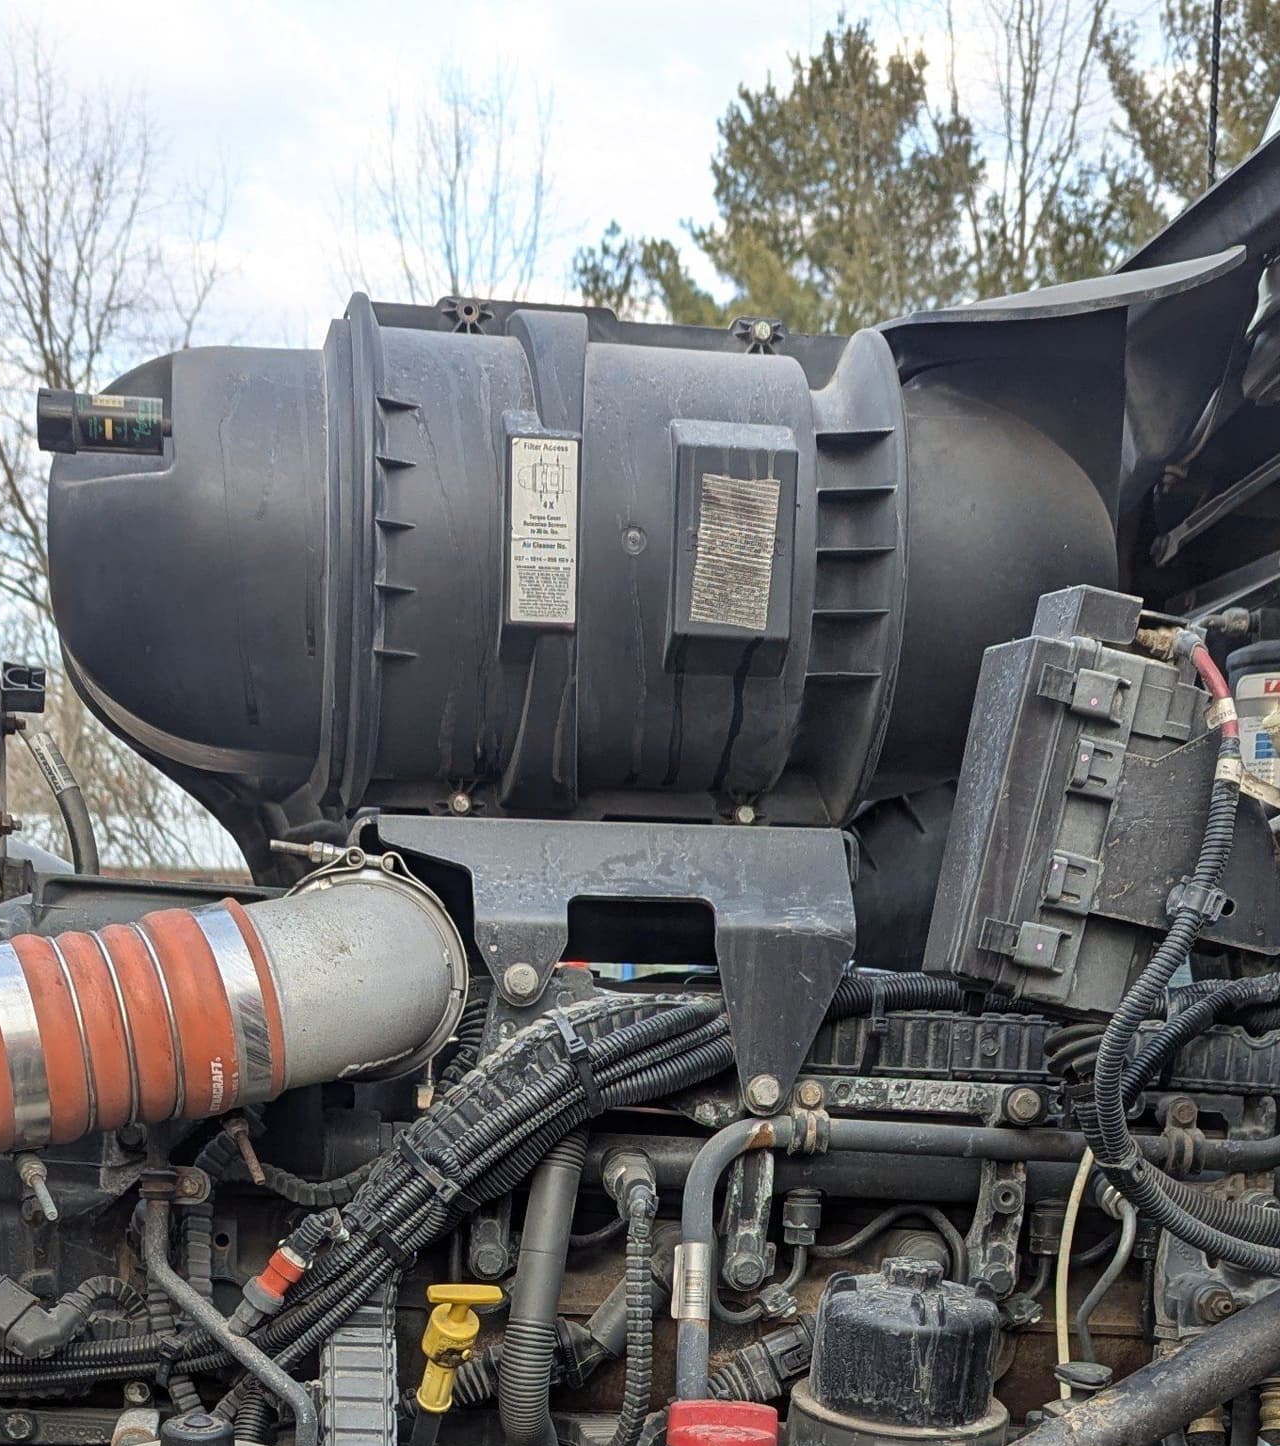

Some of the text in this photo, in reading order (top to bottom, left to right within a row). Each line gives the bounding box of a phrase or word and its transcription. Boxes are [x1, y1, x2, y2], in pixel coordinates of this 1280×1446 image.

[523, 442, 569, 452] Filter Access
[543, 501, 554, 510] 4 X
[533, 542, 556, 550] Cleaner
[557, 542, 567, 550] No.
